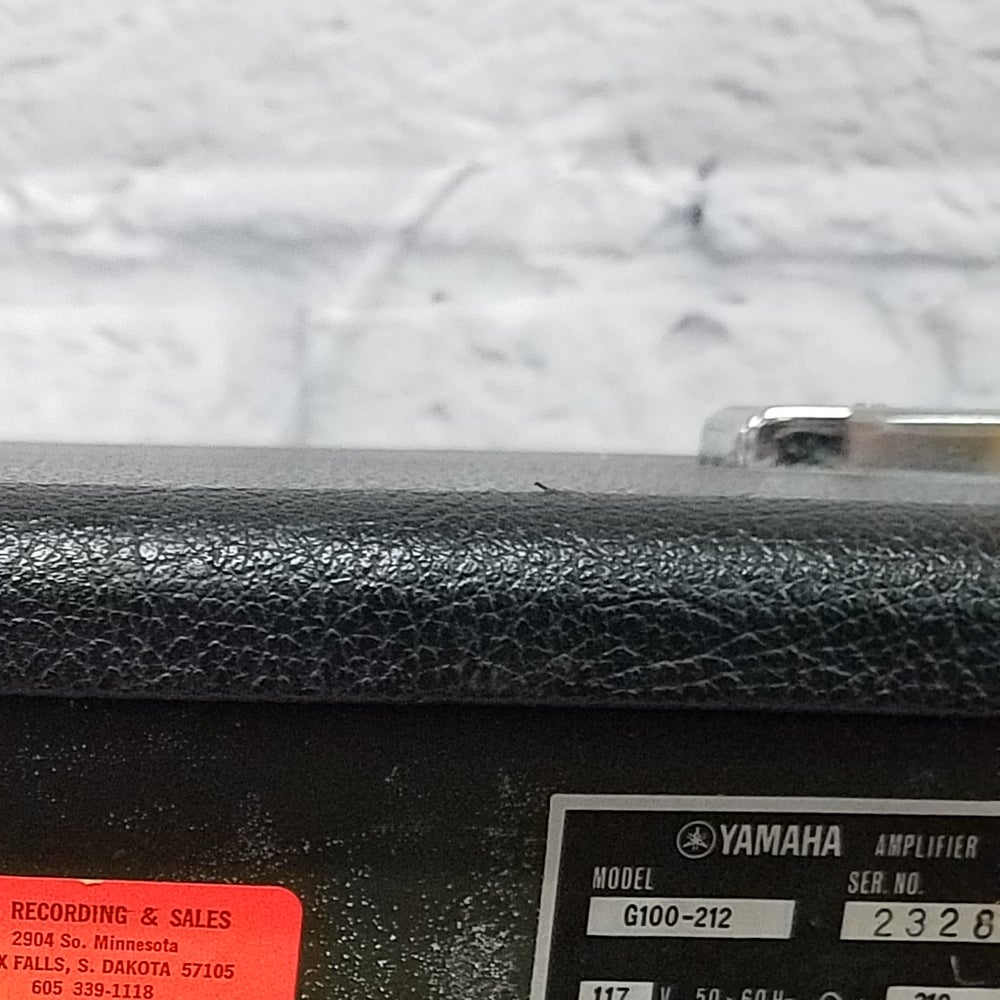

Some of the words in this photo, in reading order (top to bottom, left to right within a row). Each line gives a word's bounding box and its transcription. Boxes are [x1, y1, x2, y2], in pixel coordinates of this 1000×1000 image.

[720, 824, 842, 857] YAMAHA
[875, 834, 979, 859] AMPLIFIER
[592, 867, 654, 890] MODEL
[11, 901, 128, 924] RECORDING
[141, 908, 158, 926] &
[170, 909, 231, 929] SALES
[624, 904, 733, 929] G100-212
[11, 931, 54, 948] 2904
[60, 933, 86, 949] So.
[94, 935, 179, 953] Minnesota
[13, 957, 70, 974] FALLS,
[77, 958, 95, 973] S.
[102, 960, 171, 977] DAKOTA
[181, 963, 235, 979] 57105
[31, 981, 62, 996] 605
[72, 982, 154, 999] 339-1118
